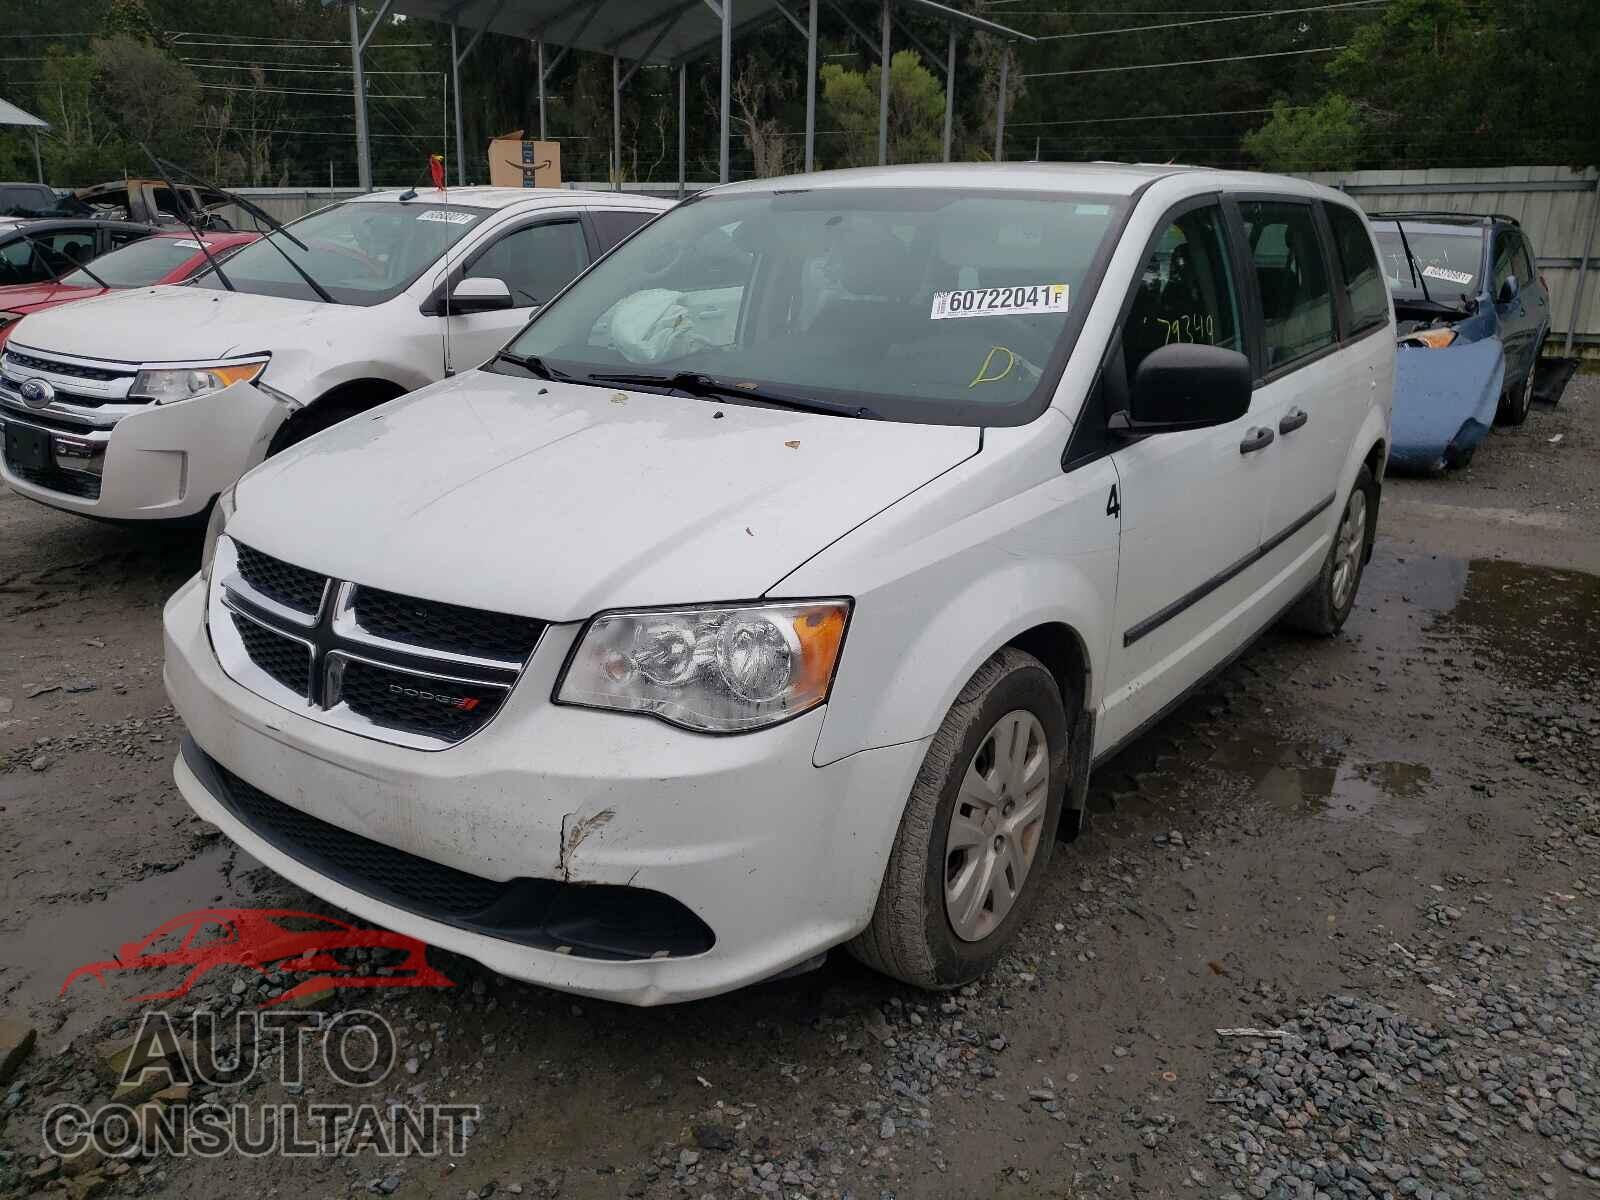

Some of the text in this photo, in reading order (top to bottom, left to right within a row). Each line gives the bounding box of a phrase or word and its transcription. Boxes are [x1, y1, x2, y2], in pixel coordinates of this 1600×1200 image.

[950, 286, 1050, 312] 60722041
[1054, 292, 1063, 304] F
[968, 345, 1015, 390] D
[1106, 483, 1121, 519] 4
[389, 683, 466, 706] DODGE
